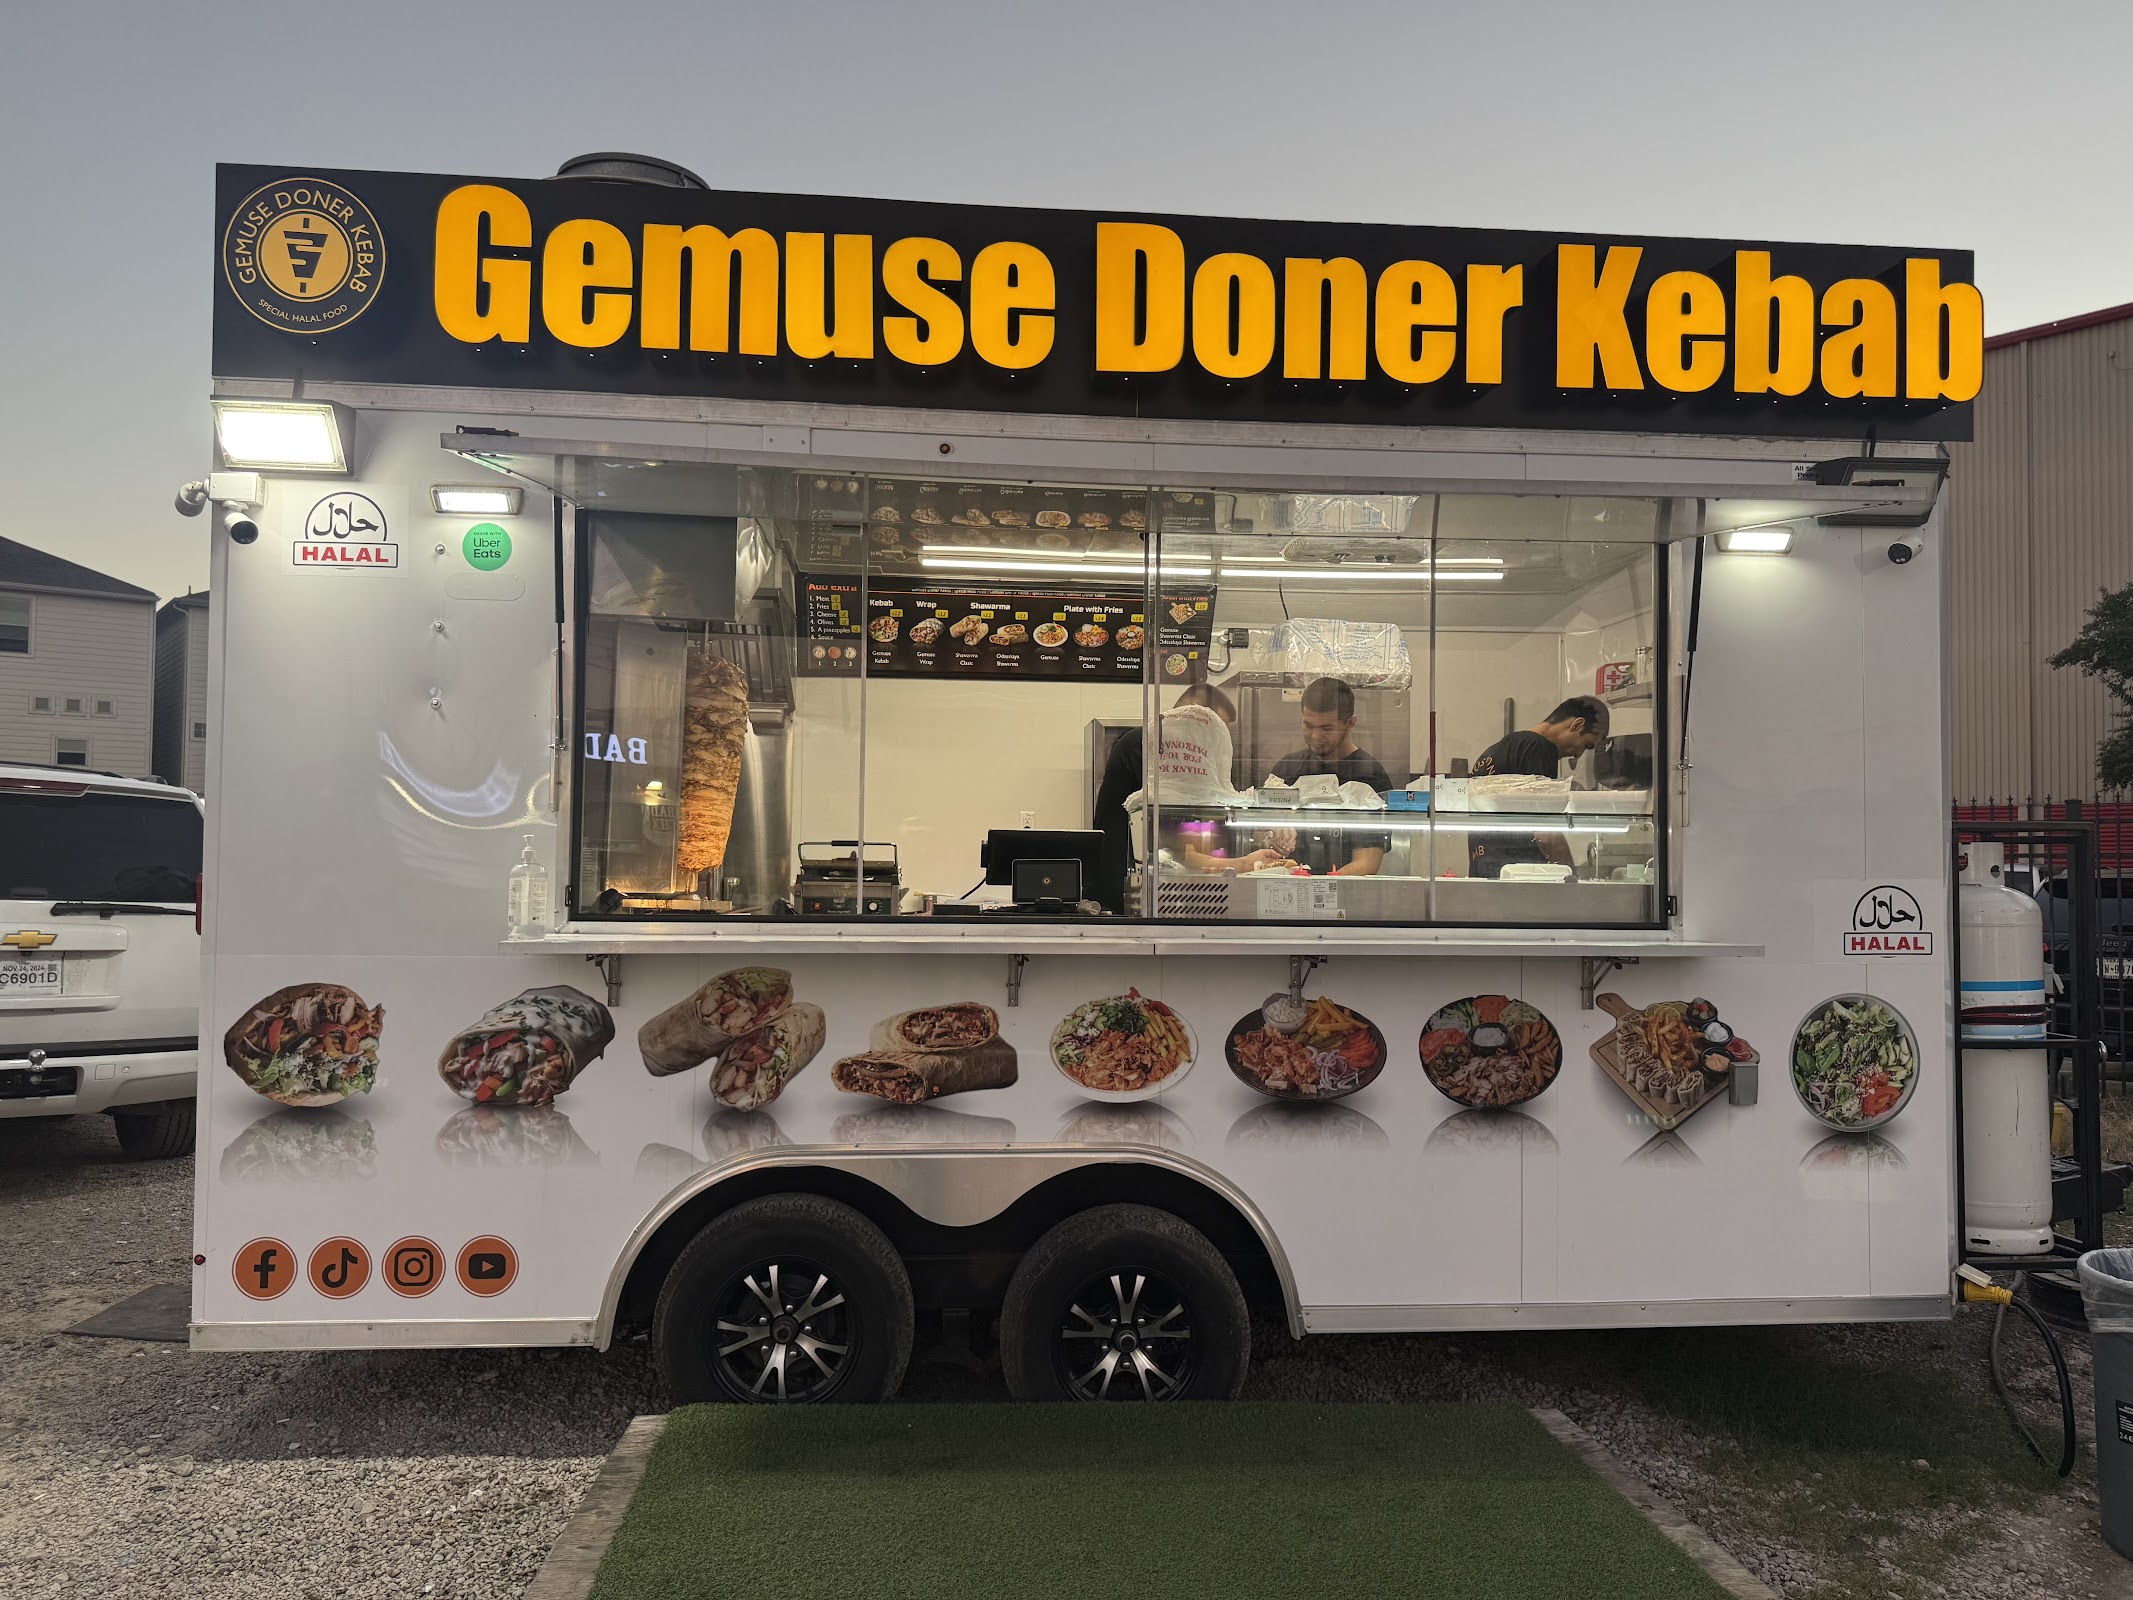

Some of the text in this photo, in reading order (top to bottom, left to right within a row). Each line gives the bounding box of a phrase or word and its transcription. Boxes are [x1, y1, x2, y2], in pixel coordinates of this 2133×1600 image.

[235, 188, 374, 293] GEMUSE DONER KEBAB
[434, 184, 1985, 402] Gemuse Doner Kebab
[258, 299, 348, 323] SPECIAL HALAL FOOD
[313, 500, 380, 539] حلال
[473, 537, 501, 548] Uber
[302, 546, 389, 563] HALAL
[473, 549, 501, 558] Eats
[869, 599, 894, 607] Kebab
[916, 600, 937, 609] Wrap
[970, 602, 1011, 610] Shawarma
[1063, 604, 1084, 613] Plate
[1164, 740, 1208, 757] PATRONA
[1183, 752, 1202, 764] FOR
[1173, 765, 1208, 776] THANK
[1859, 893, 1916, 930] حلال
[1851, 936, 1925, 951] HALAL
[0, 972, 57, 984] C6901D
